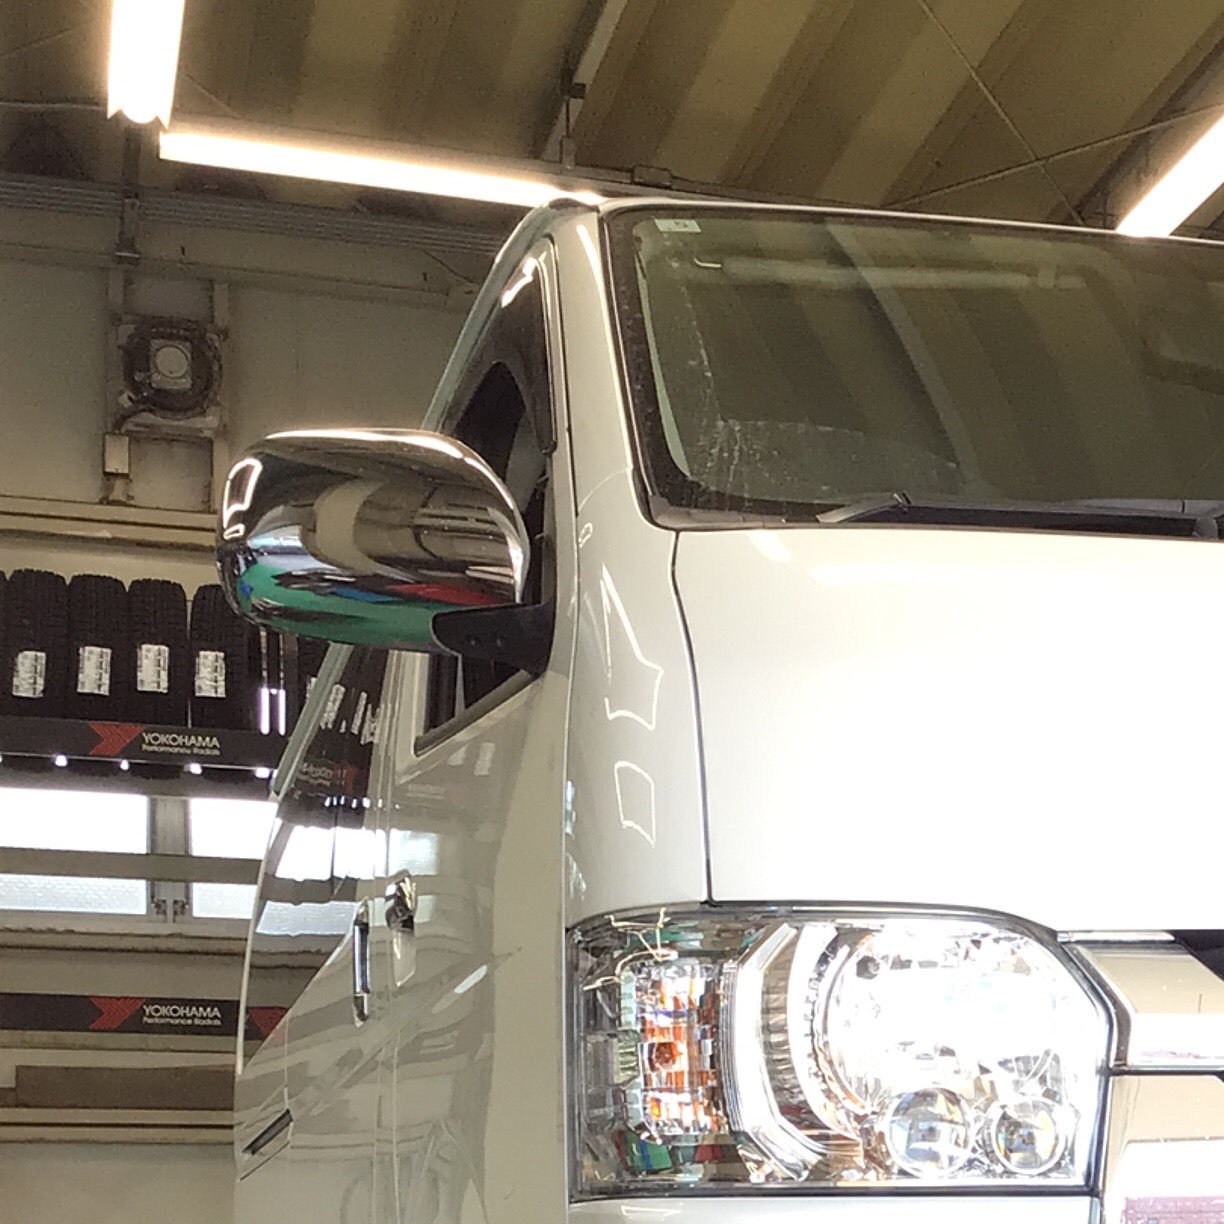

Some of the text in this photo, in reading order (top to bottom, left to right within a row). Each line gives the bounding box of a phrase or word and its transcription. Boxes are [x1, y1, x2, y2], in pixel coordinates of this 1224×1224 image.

[142, 732, 220, 748] YOKOHAMA
[143, 1004, 221, 1018] YOKOHAMA
[143, 1016, 222, 1026] Performance Radials
